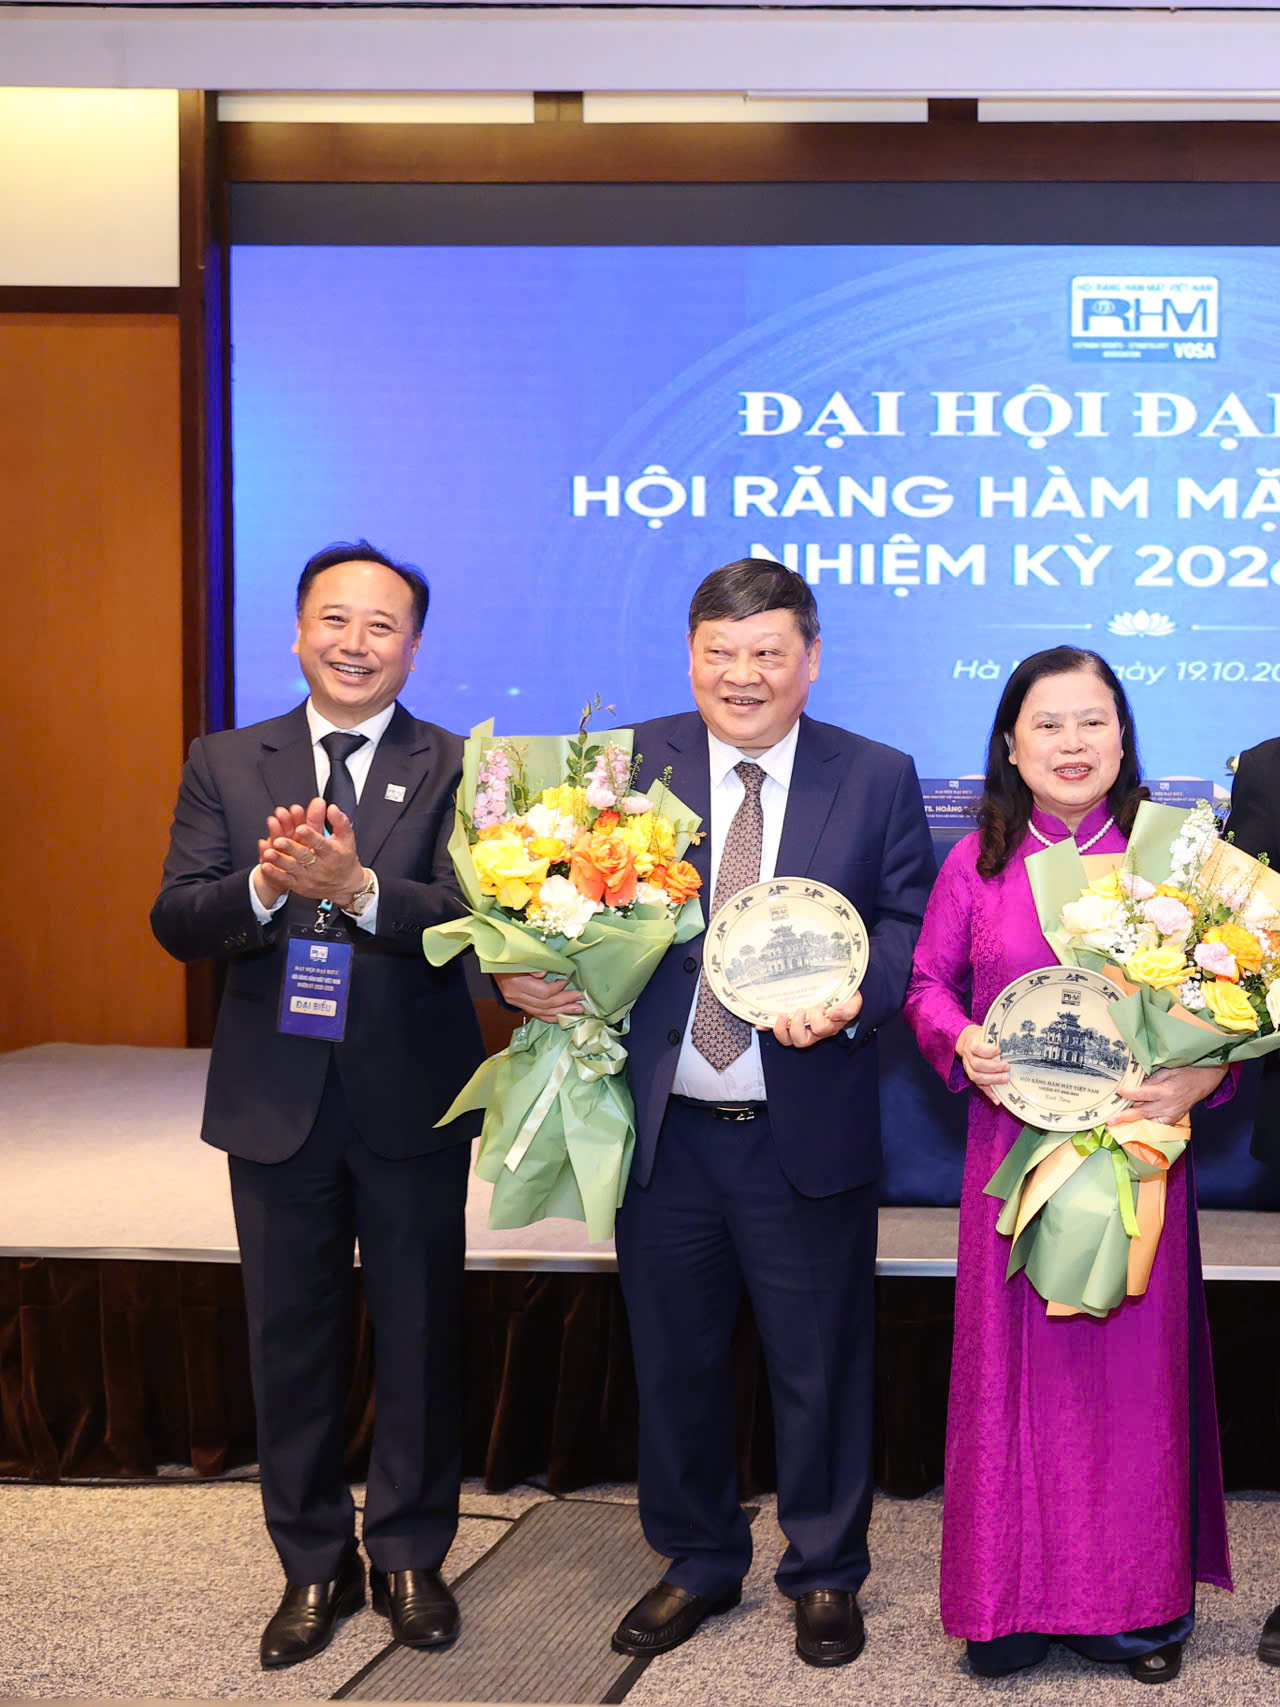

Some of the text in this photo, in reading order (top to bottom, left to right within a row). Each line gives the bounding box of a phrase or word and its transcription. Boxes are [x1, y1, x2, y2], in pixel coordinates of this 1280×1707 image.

[1082, 298, 1208, 332] RHM
[739, 392, 905, 449] ĐẠI
[930, 384, 1109, 449] HỘI
[573, 464, 705, 529] HỘI
[734, 465, 953, 518] RĂNG
[980, 466, 1148, 519] HÀM
[751, 533, 986, 597] NHIỆM
[1014, 534, 1112, 587] KỲ
[953, 659, 1000, 680] Hà
